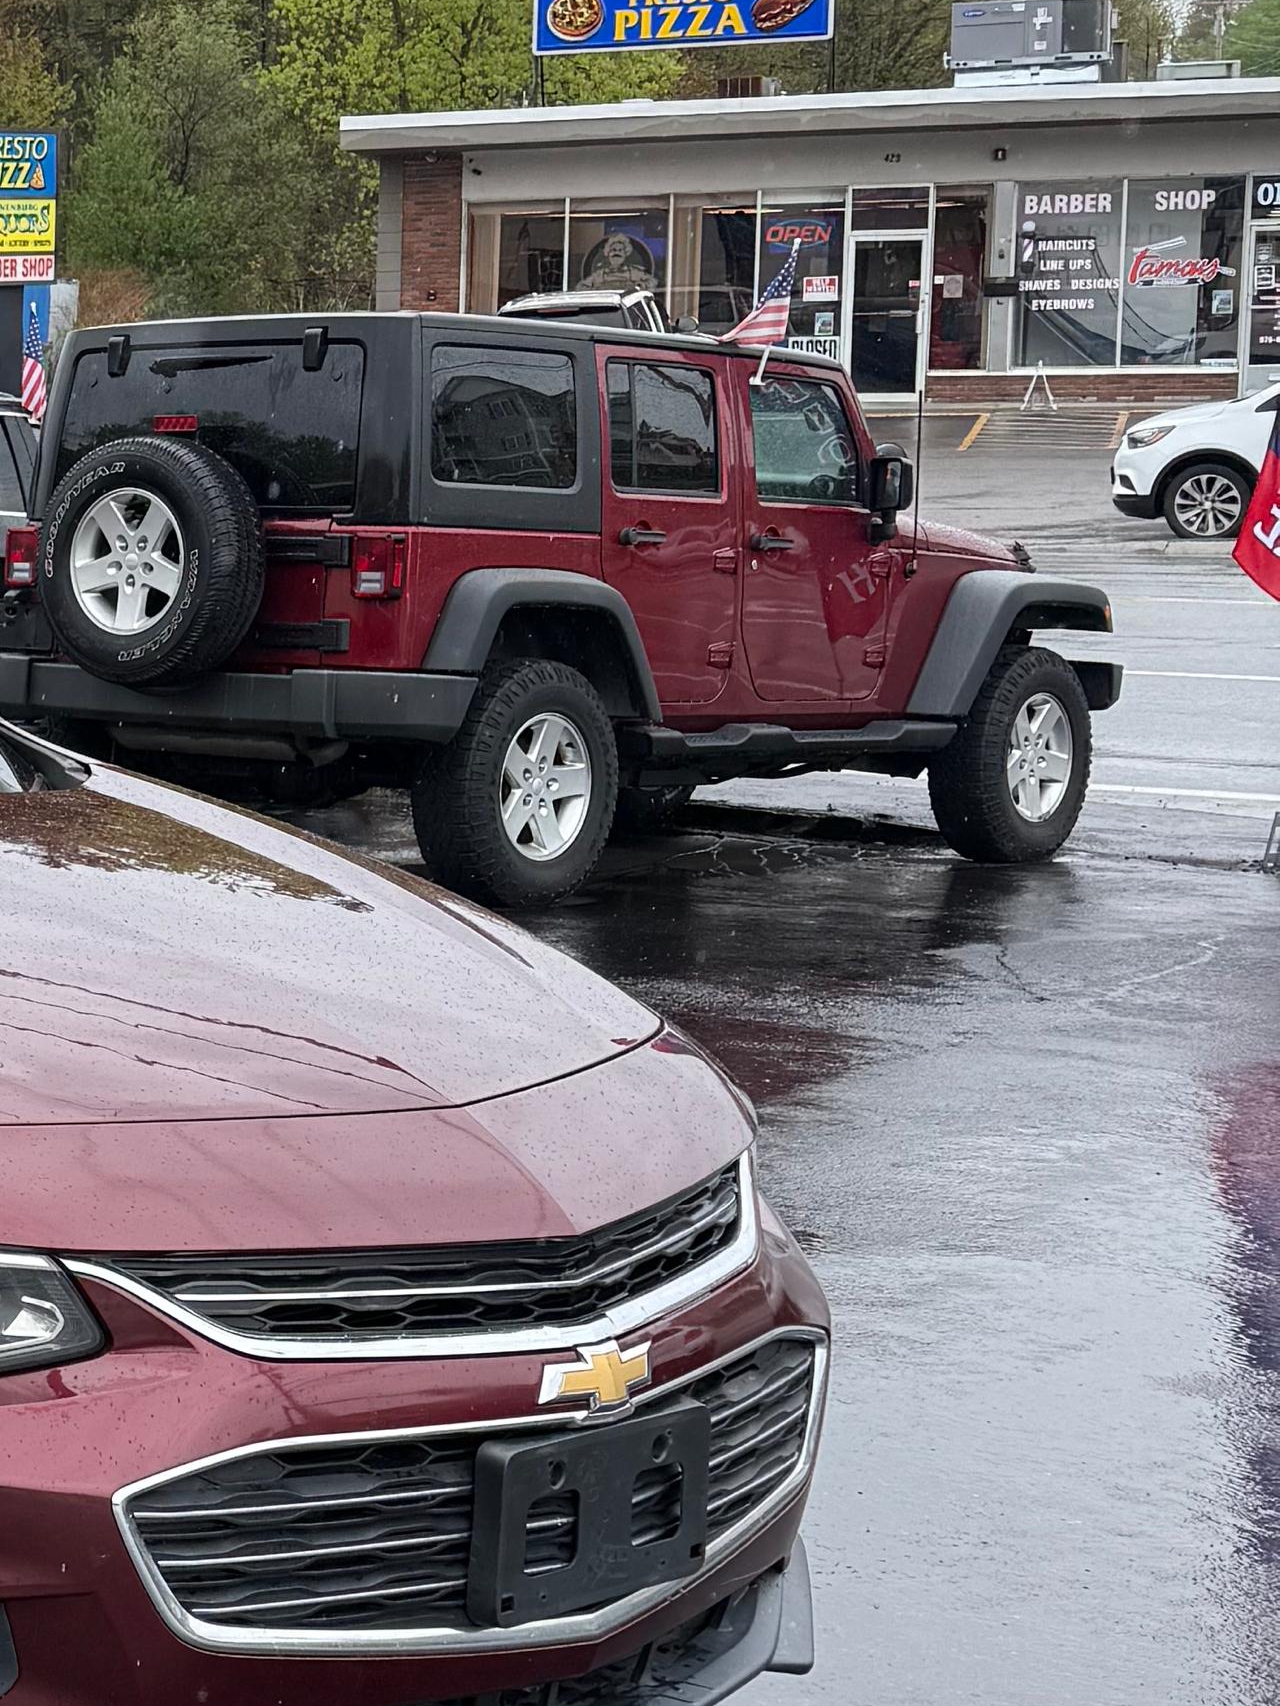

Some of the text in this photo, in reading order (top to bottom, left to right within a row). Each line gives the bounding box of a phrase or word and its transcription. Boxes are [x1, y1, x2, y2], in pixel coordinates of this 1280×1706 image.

[614, 4, 749, 41] PIZZA
[1025, 190, 1216, 214] BARBER SHOP
[766, 225, 832, 242] OPEN
[1038, 239, 1095, 251] HAIRCUTS
[22, 257, 53, 278] SHOP
[1041, 259, 1091, 270] LINE UPS
[1019, 278, 1119, 291] SHAVES DESIGNS
[1032, 299, 1095, 310] EYEBROWS
[44, 461, 126, 578] GOODYEAR
